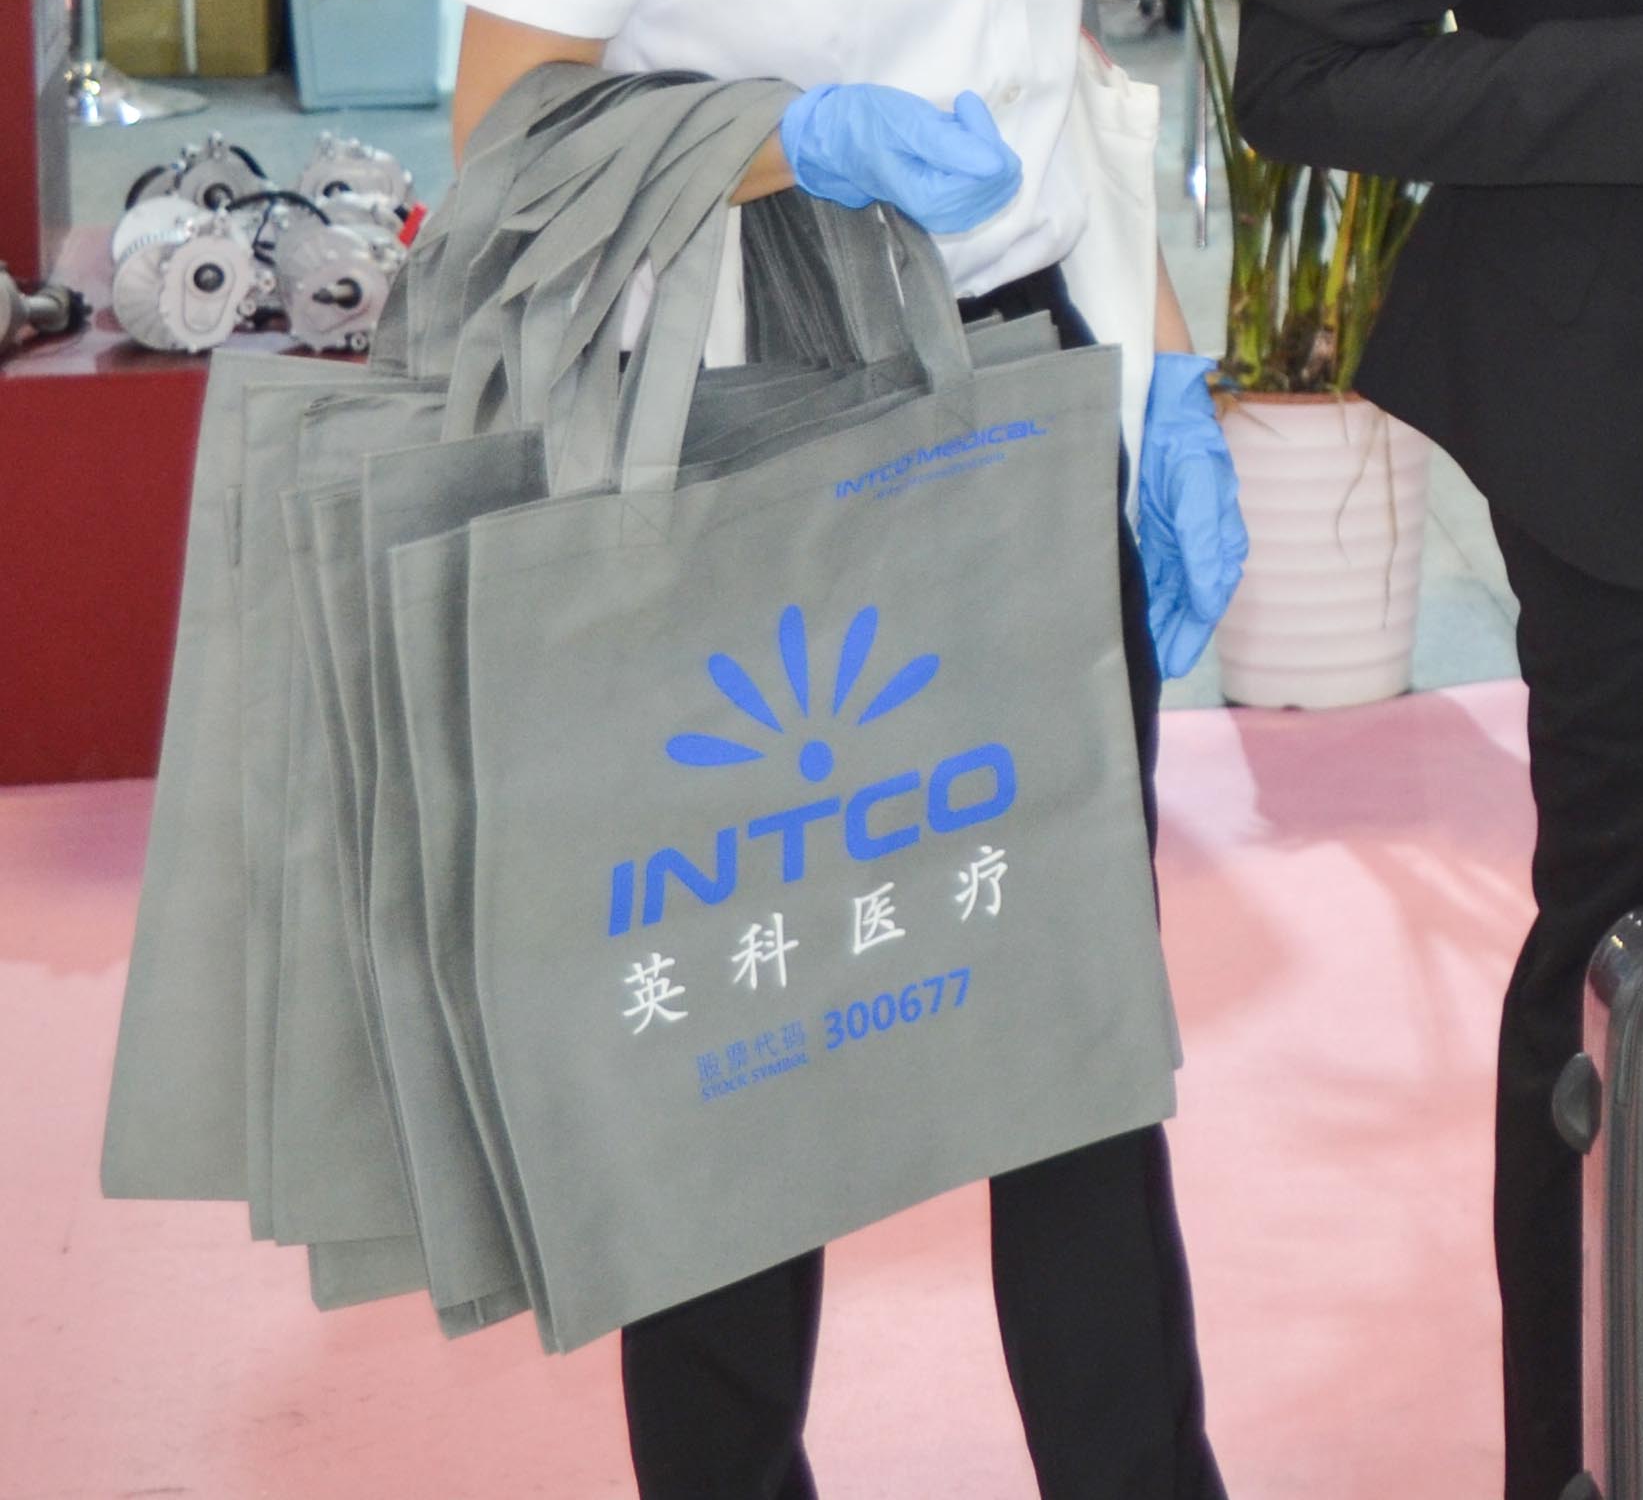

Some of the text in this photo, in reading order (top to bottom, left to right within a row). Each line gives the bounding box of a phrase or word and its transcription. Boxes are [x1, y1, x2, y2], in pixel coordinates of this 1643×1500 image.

[608, 742, 1018, 937] INTCO
[622, 844, 1009, 1035] 英科医疗
[822, 965, 972, 1051] 300677
